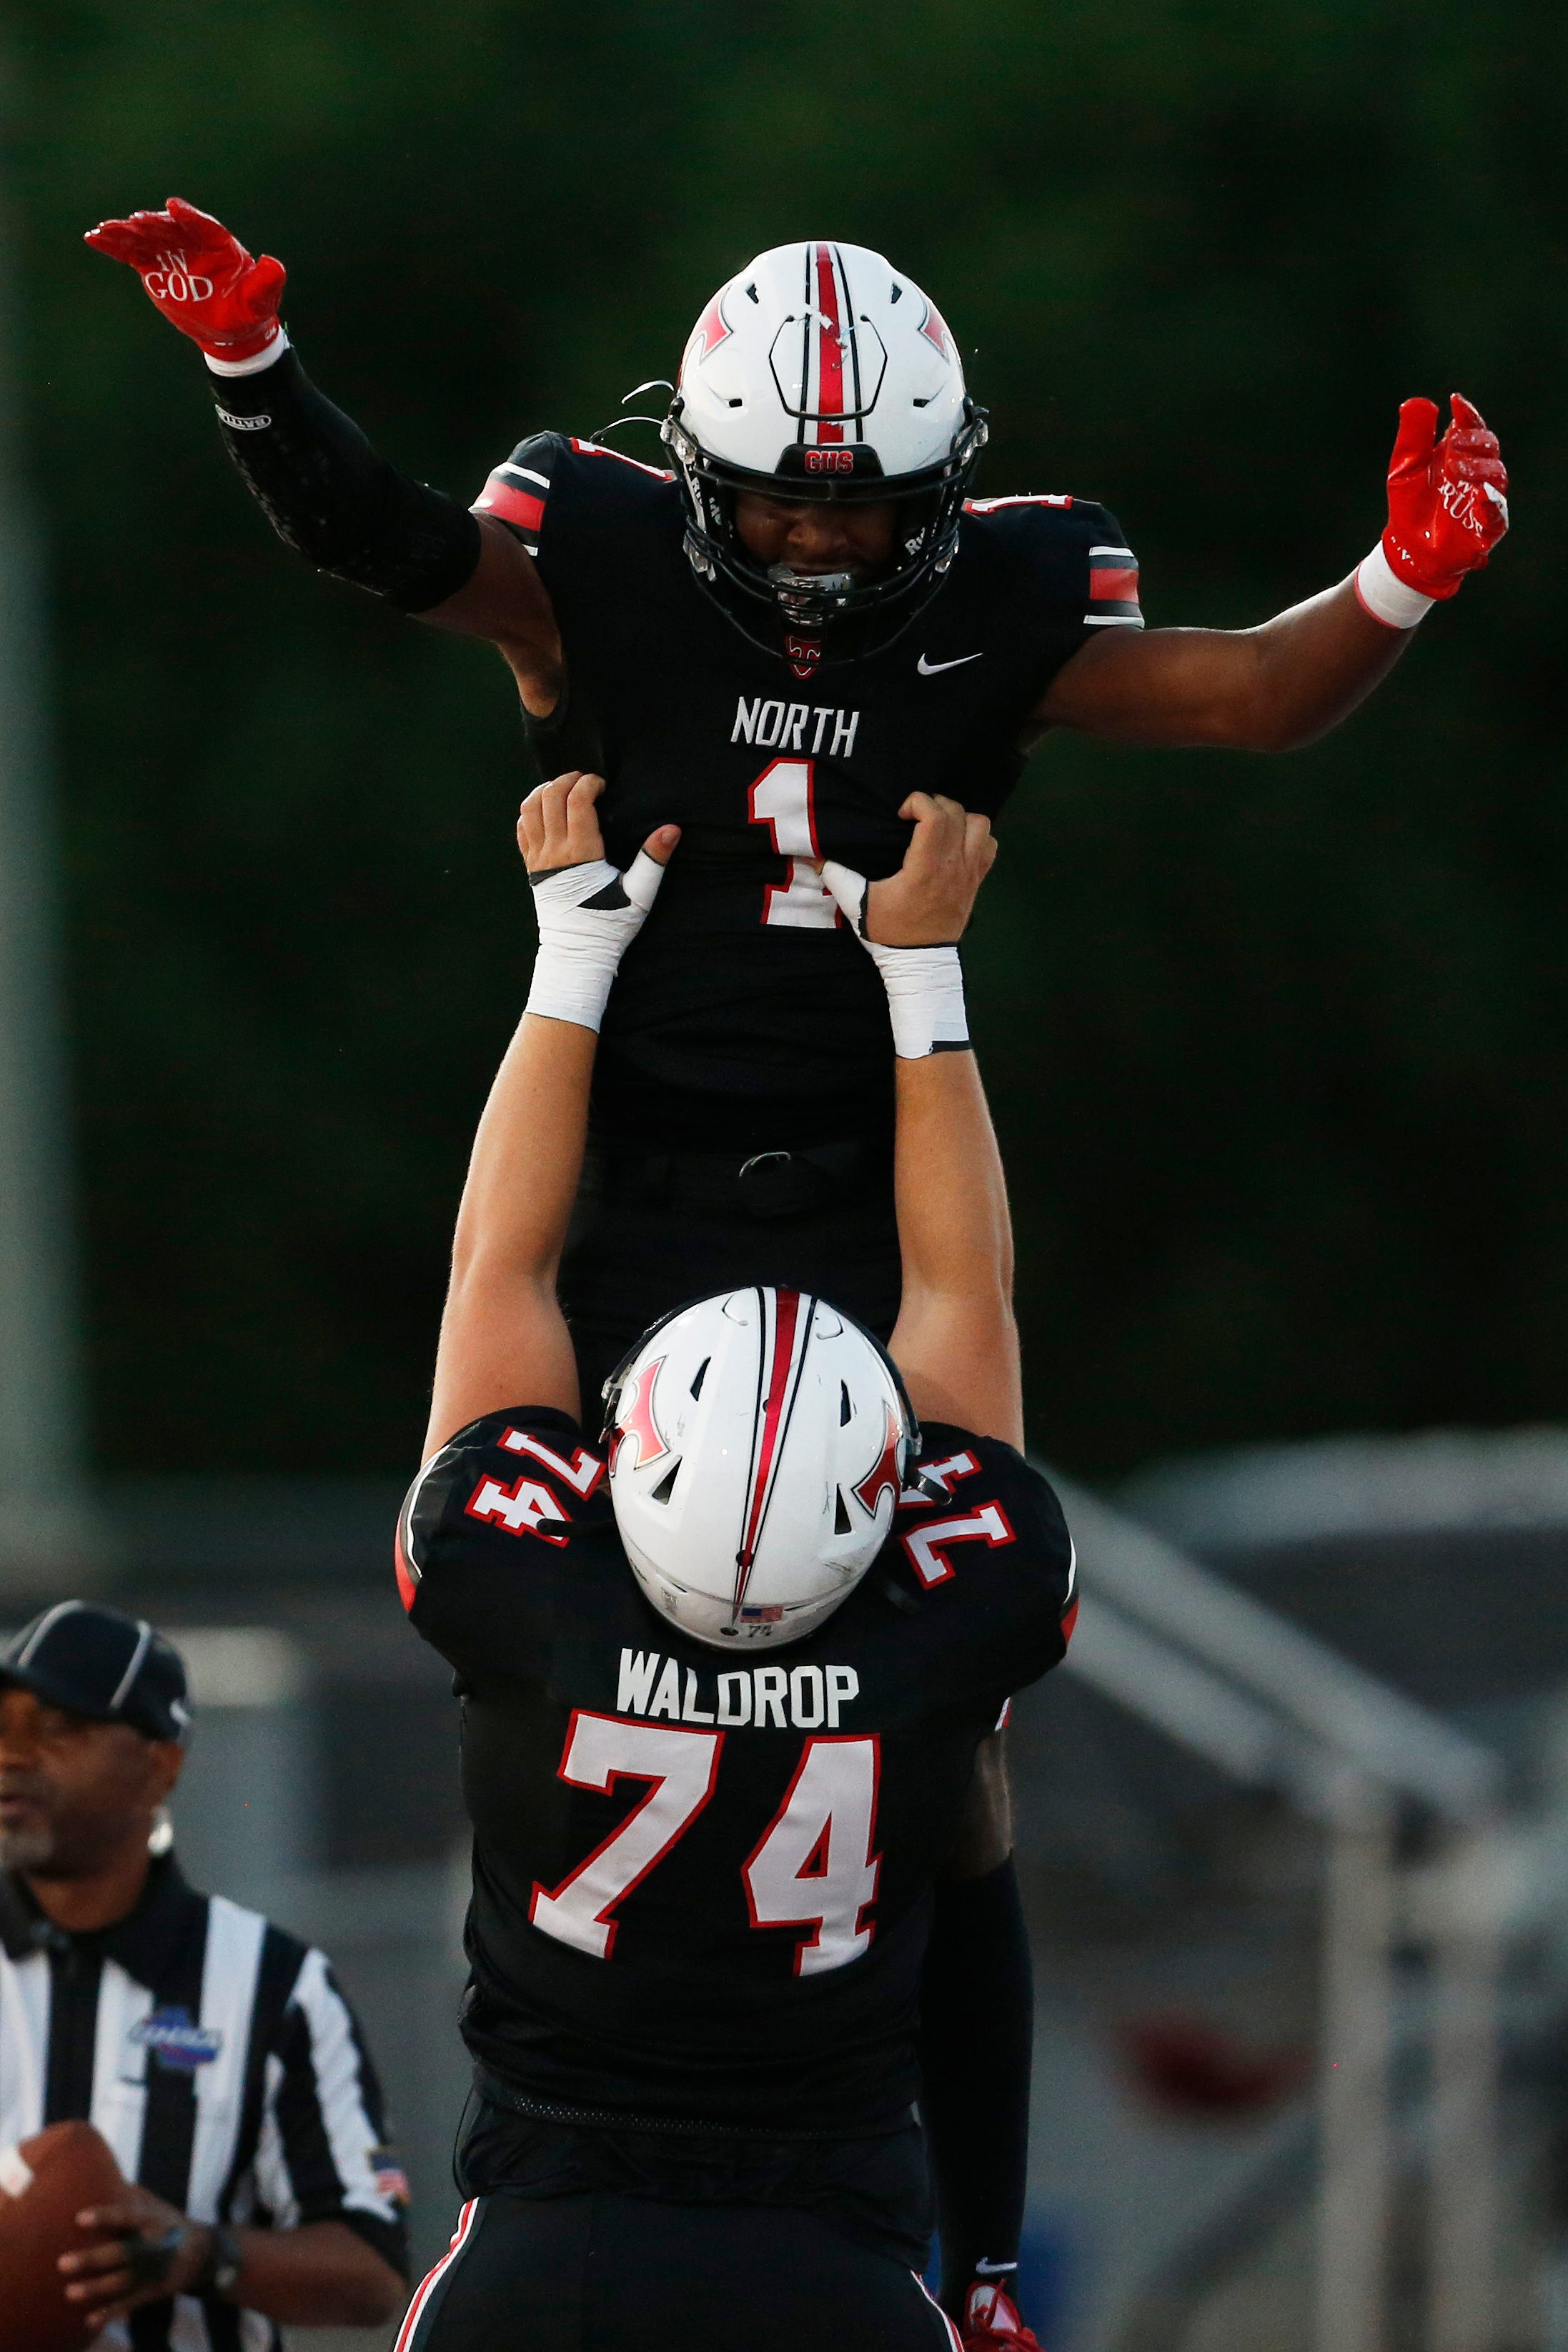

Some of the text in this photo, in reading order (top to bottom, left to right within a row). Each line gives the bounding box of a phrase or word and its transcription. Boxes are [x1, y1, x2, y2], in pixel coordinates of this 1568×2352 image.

[144, 272, 214, 302] GOD
[156, 248, 188, 274] IN
[805, 450, 853, 474] GUS
[730, 696, 860, 758] NORTH
[746, 757, 844, 929] 1
[465, 1426, 607, 1548] 74
[616, 1647, 860, 1728] WALDROP
[527, 1708, 883, 1978] 74
